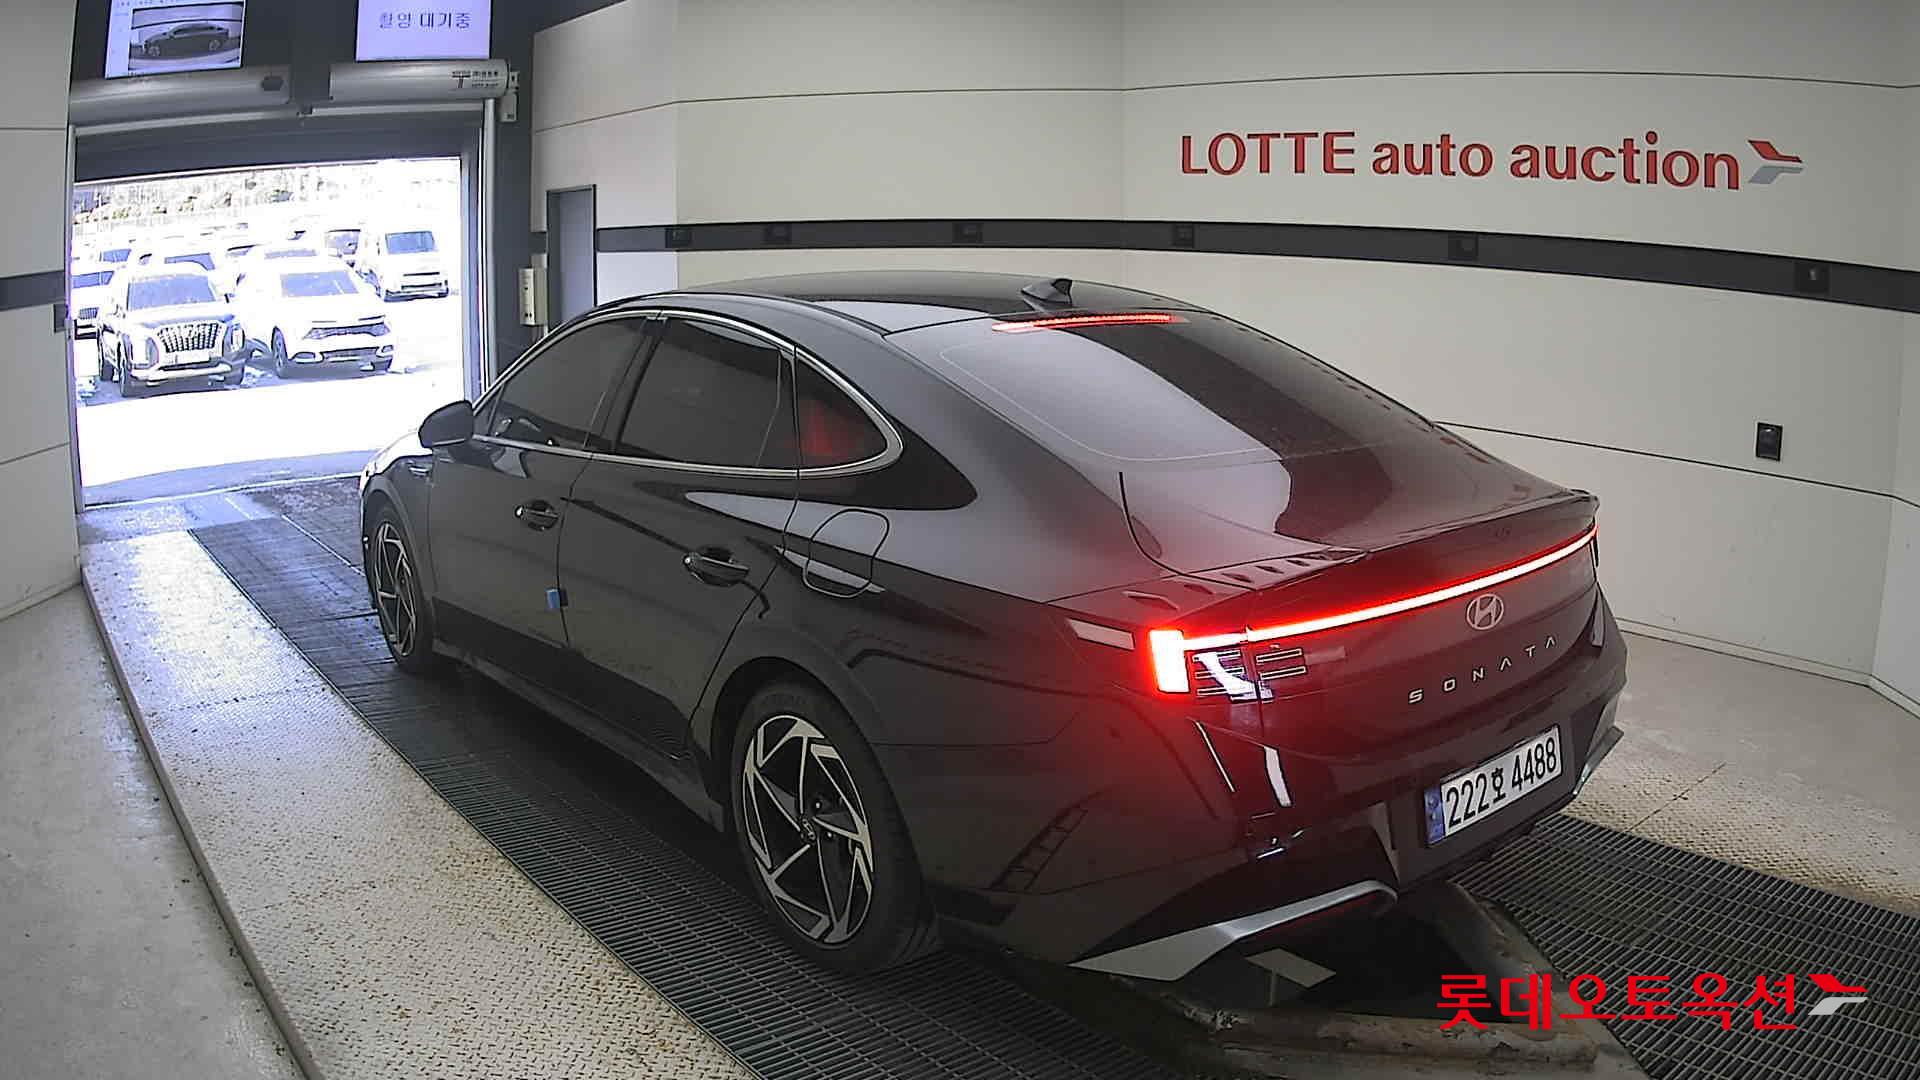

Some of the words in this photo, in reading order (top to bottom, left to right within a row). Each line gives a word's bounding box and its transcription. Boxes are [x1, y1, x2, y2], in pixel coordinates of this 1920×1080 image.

[420, 12, 471, 29] 대기중
[1181, 131, 1356, 175] LOTTE
[1372, 134, 1494, 177] auto
[1510, 131, 1740, 190] auction
[1408, 636, 1556, 704] SONATA
[1446, 767, 1506, 828] 222호
[1511, 737, 1557, 791] 4488
